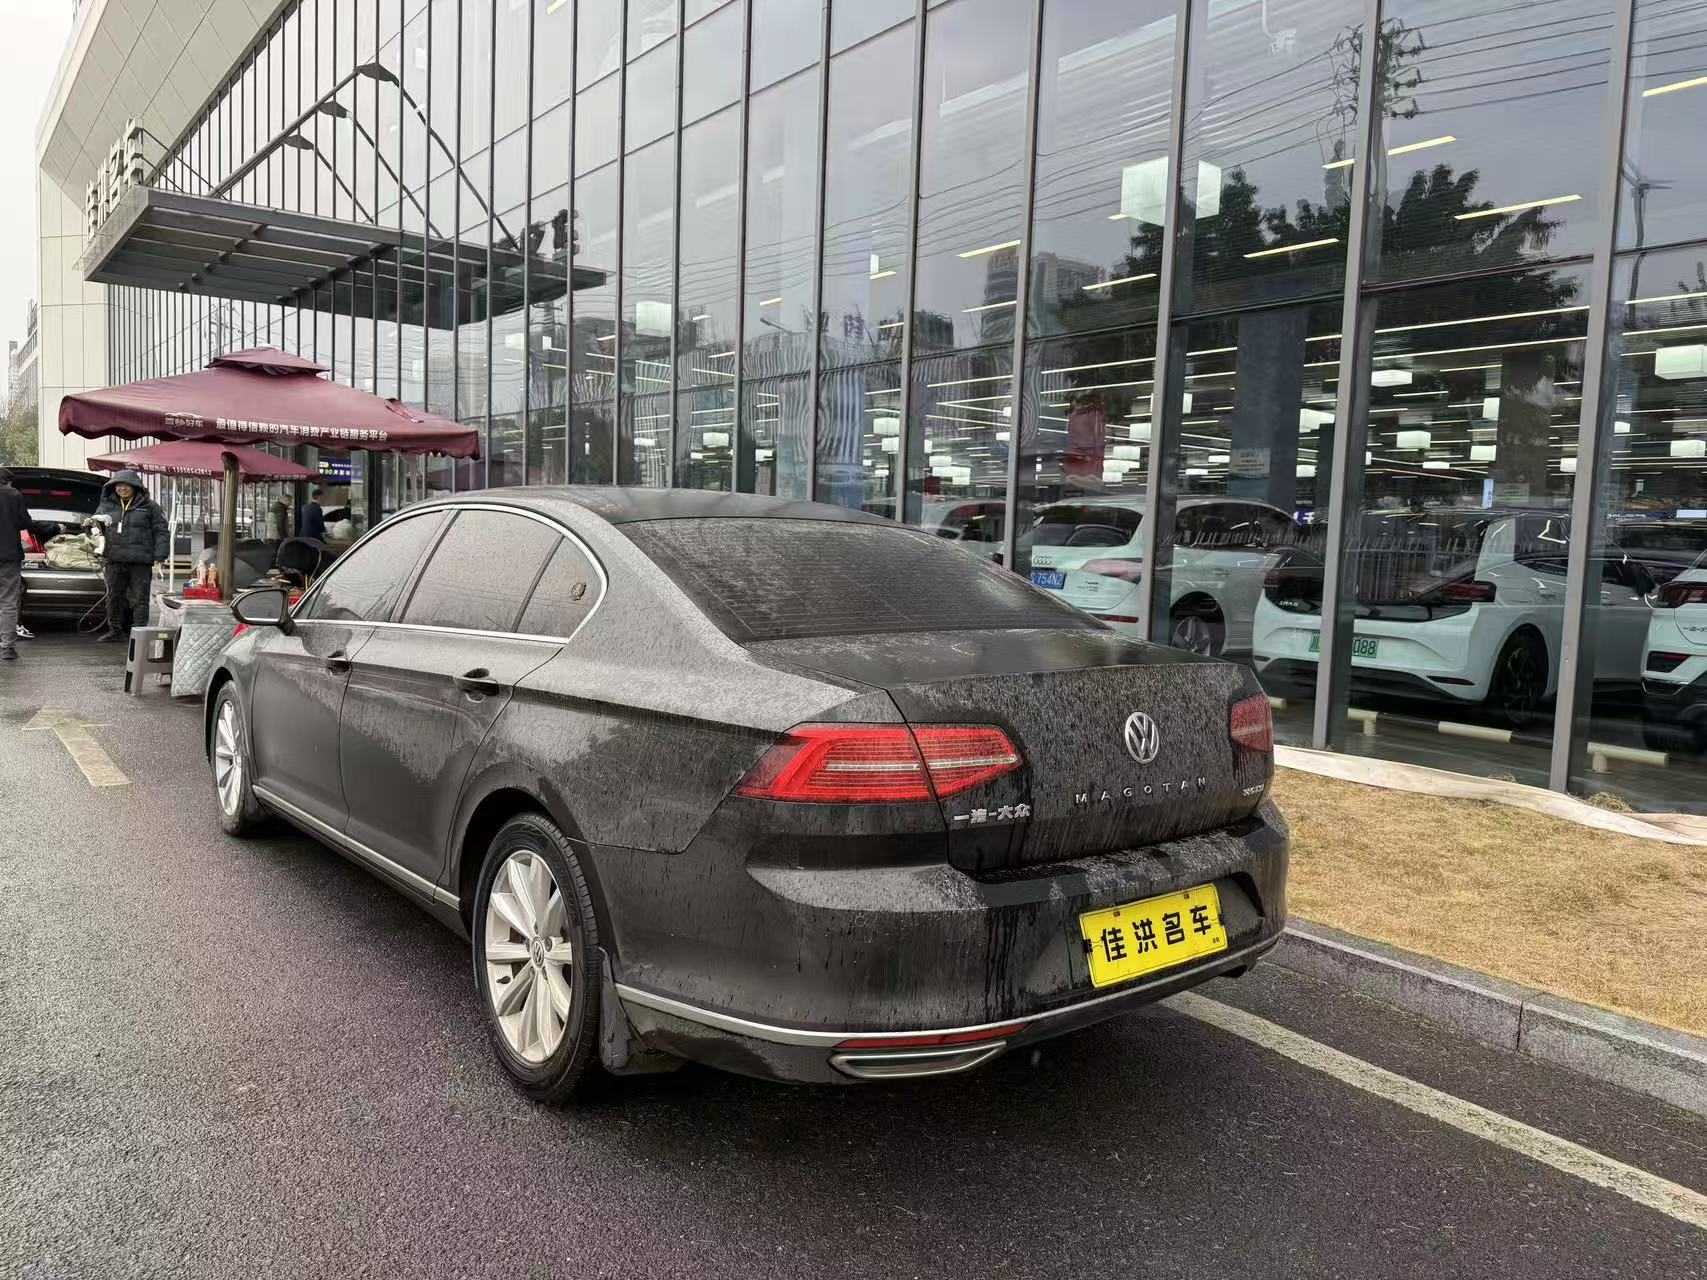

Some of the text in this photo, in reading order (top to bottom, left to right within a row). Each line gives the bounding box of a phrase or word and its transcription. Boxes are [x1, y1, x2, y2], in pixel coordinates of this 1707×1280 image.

[1075, 776, 1207, 804] MAGOTAN
[1101, 904, 1212, 963] 佳洪名车
